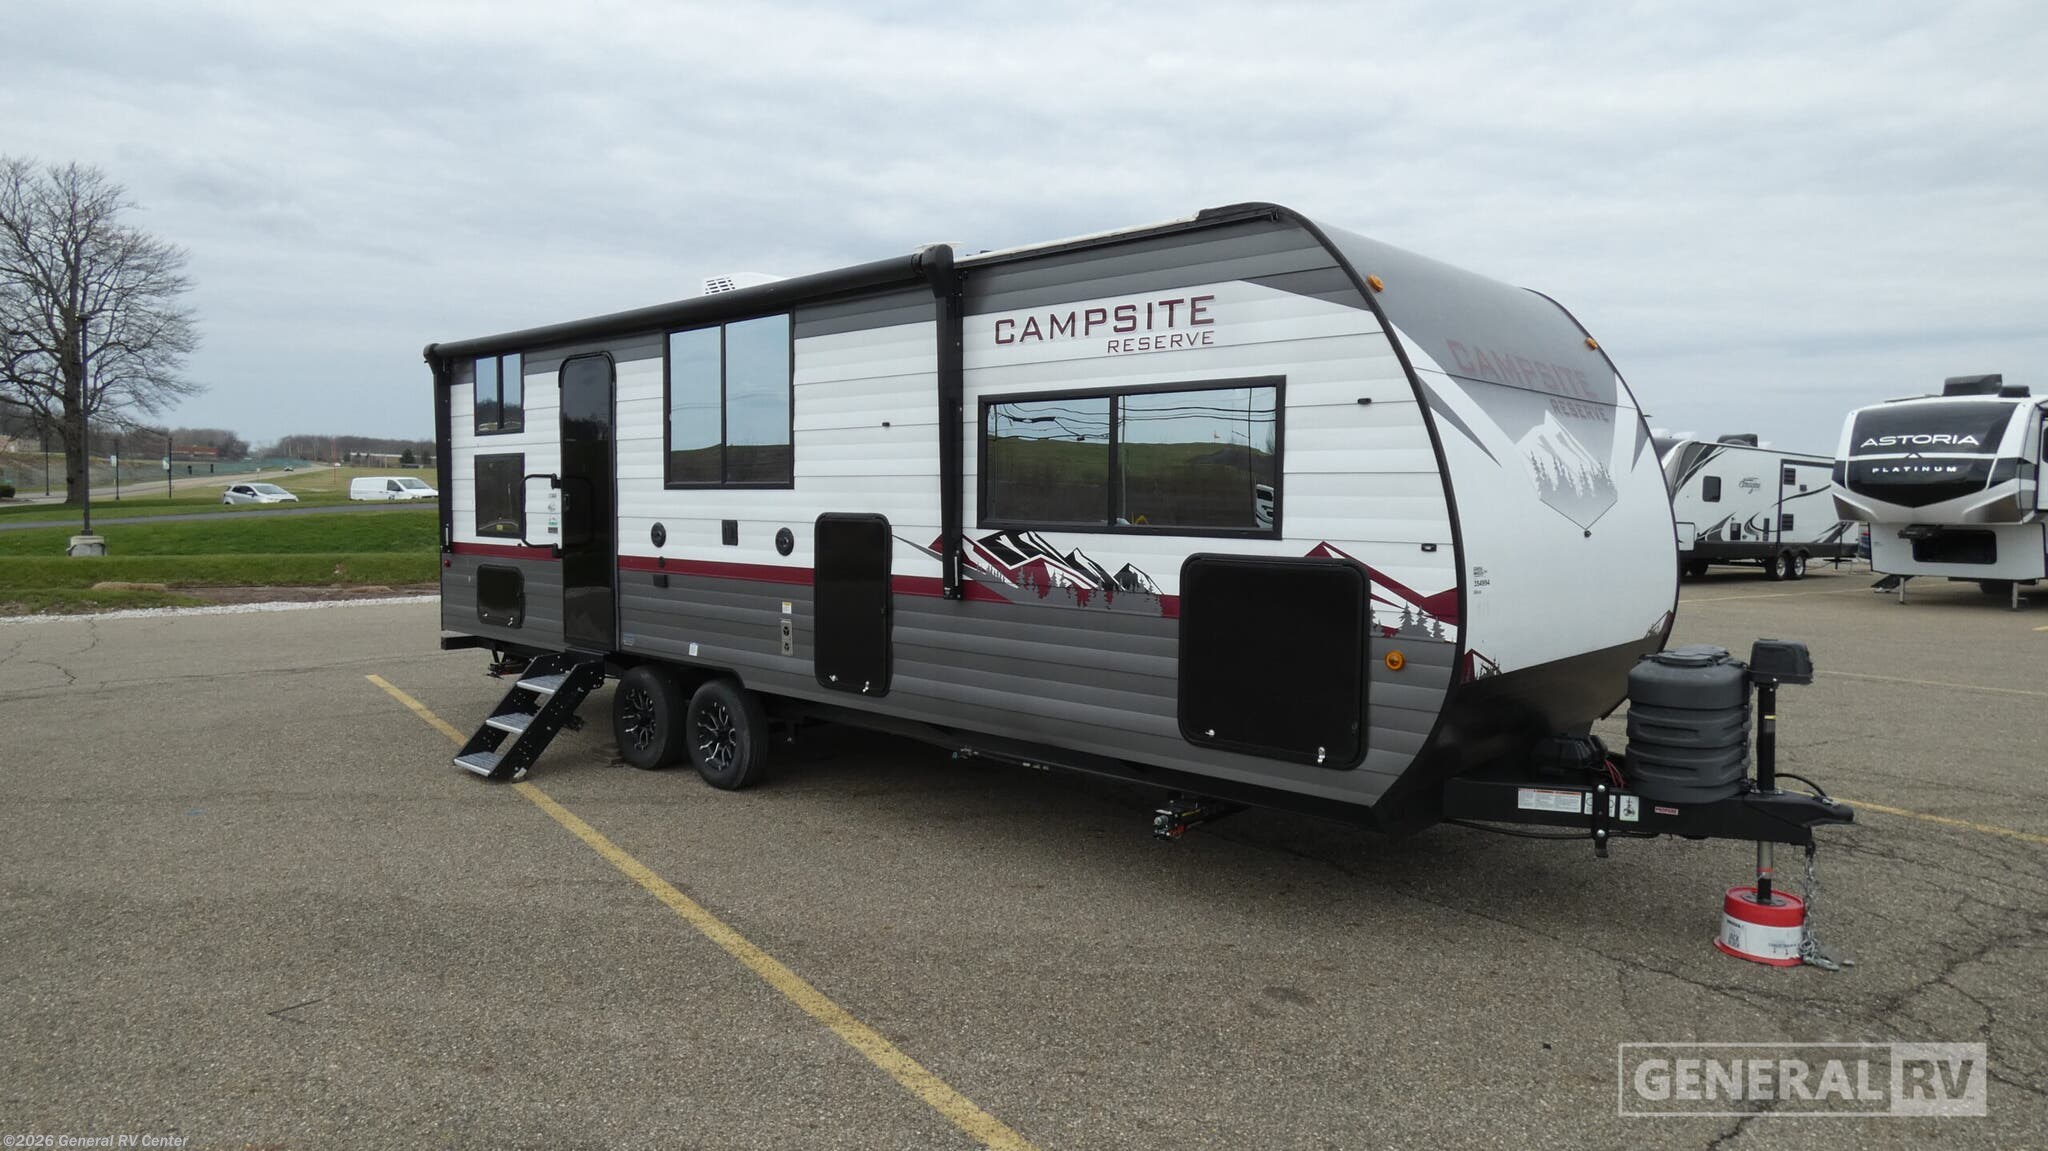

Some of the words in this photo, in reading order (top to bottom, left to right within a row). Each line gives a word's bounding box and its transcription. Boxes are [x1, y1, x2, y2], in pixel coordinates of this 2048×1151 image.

[995, 295, 1214, 345] CAMPSITE
[1107, 330, 1215, 353] RESERVE
[1446, 338, 1600, 399] CAMPSITE
[1551, 398, 1609, 423] RESERVE
[1860, 434, 1980, 448] ASTORIA
[1871, 465, 1958, 474] PLATINUM
